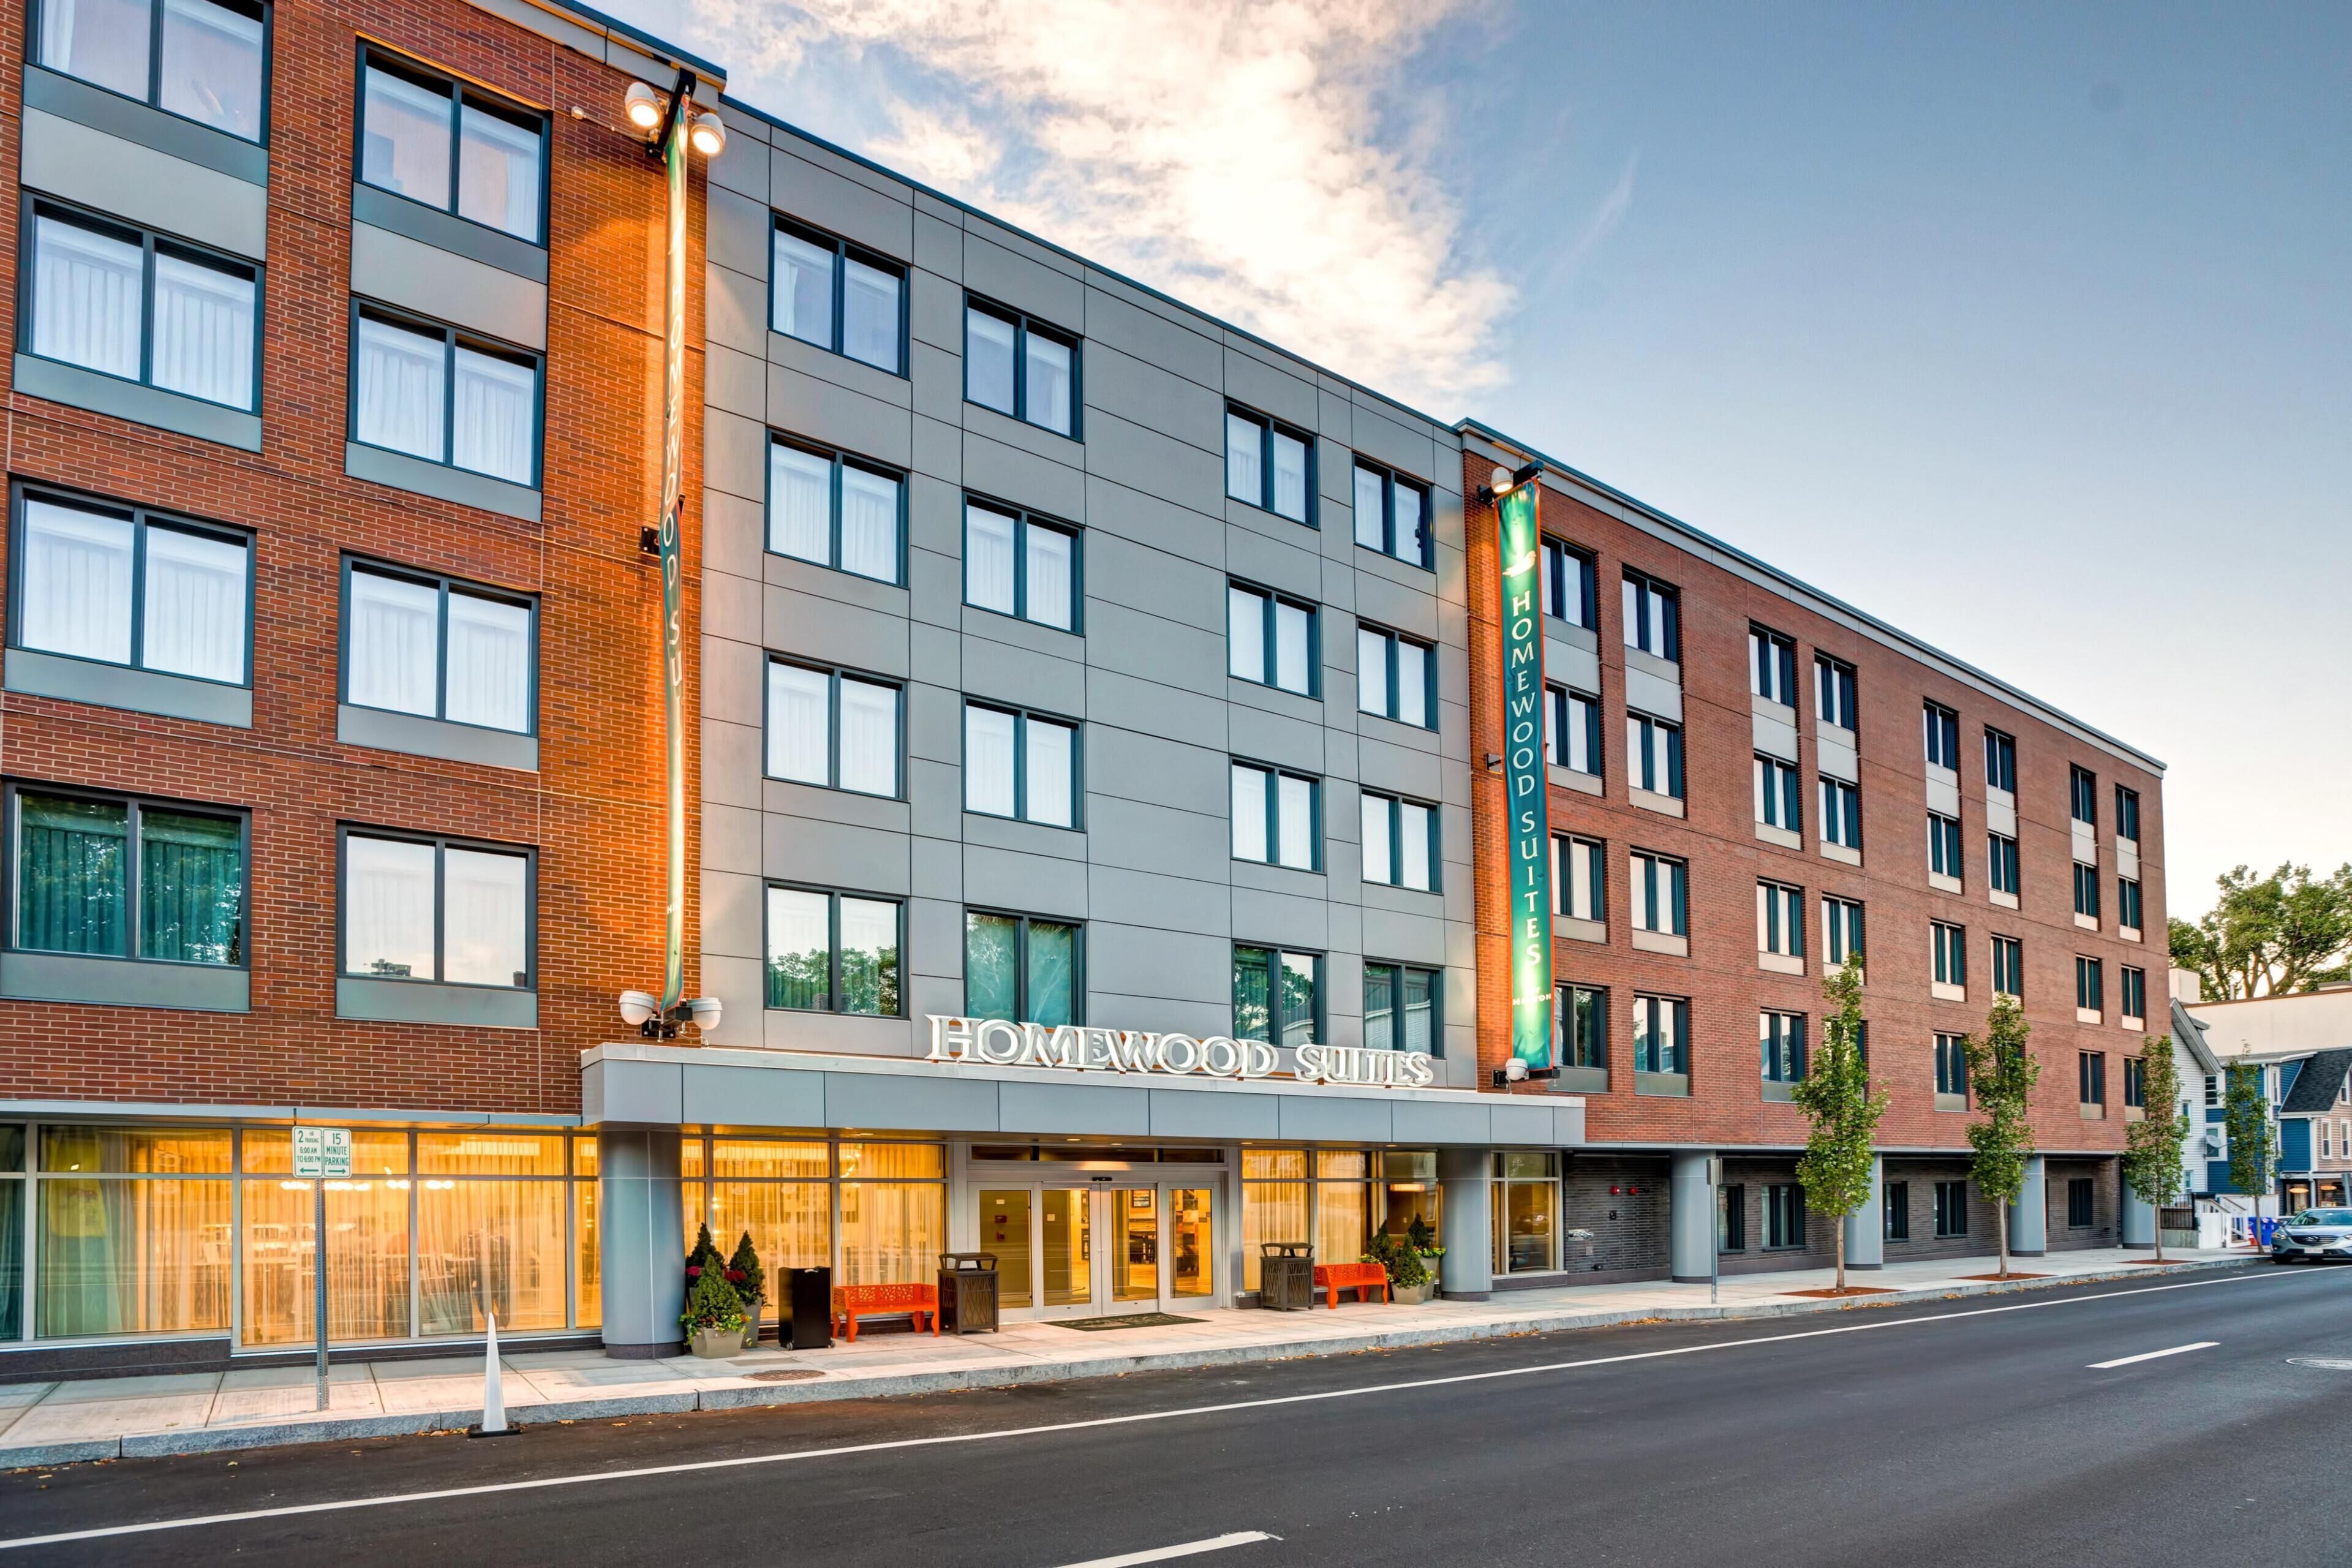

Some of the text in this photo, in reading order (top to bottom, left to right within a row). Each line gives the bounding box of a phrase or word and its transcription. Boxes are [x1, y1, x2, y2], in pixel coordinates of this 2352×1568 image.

[1511, 589, 1536, 797] HOMEWOOD
[1520, 810, 1541, 966] SUITES
[924, 1014, 1434, 1088] HOMEWOOD SUITES
[298, 1131, 304, 1143] 2
[332, 1133, 341, 1145] 15
[326, 1146, 347, 1155] MINUTE
[325, 1156, 349, 1166] PARKING
